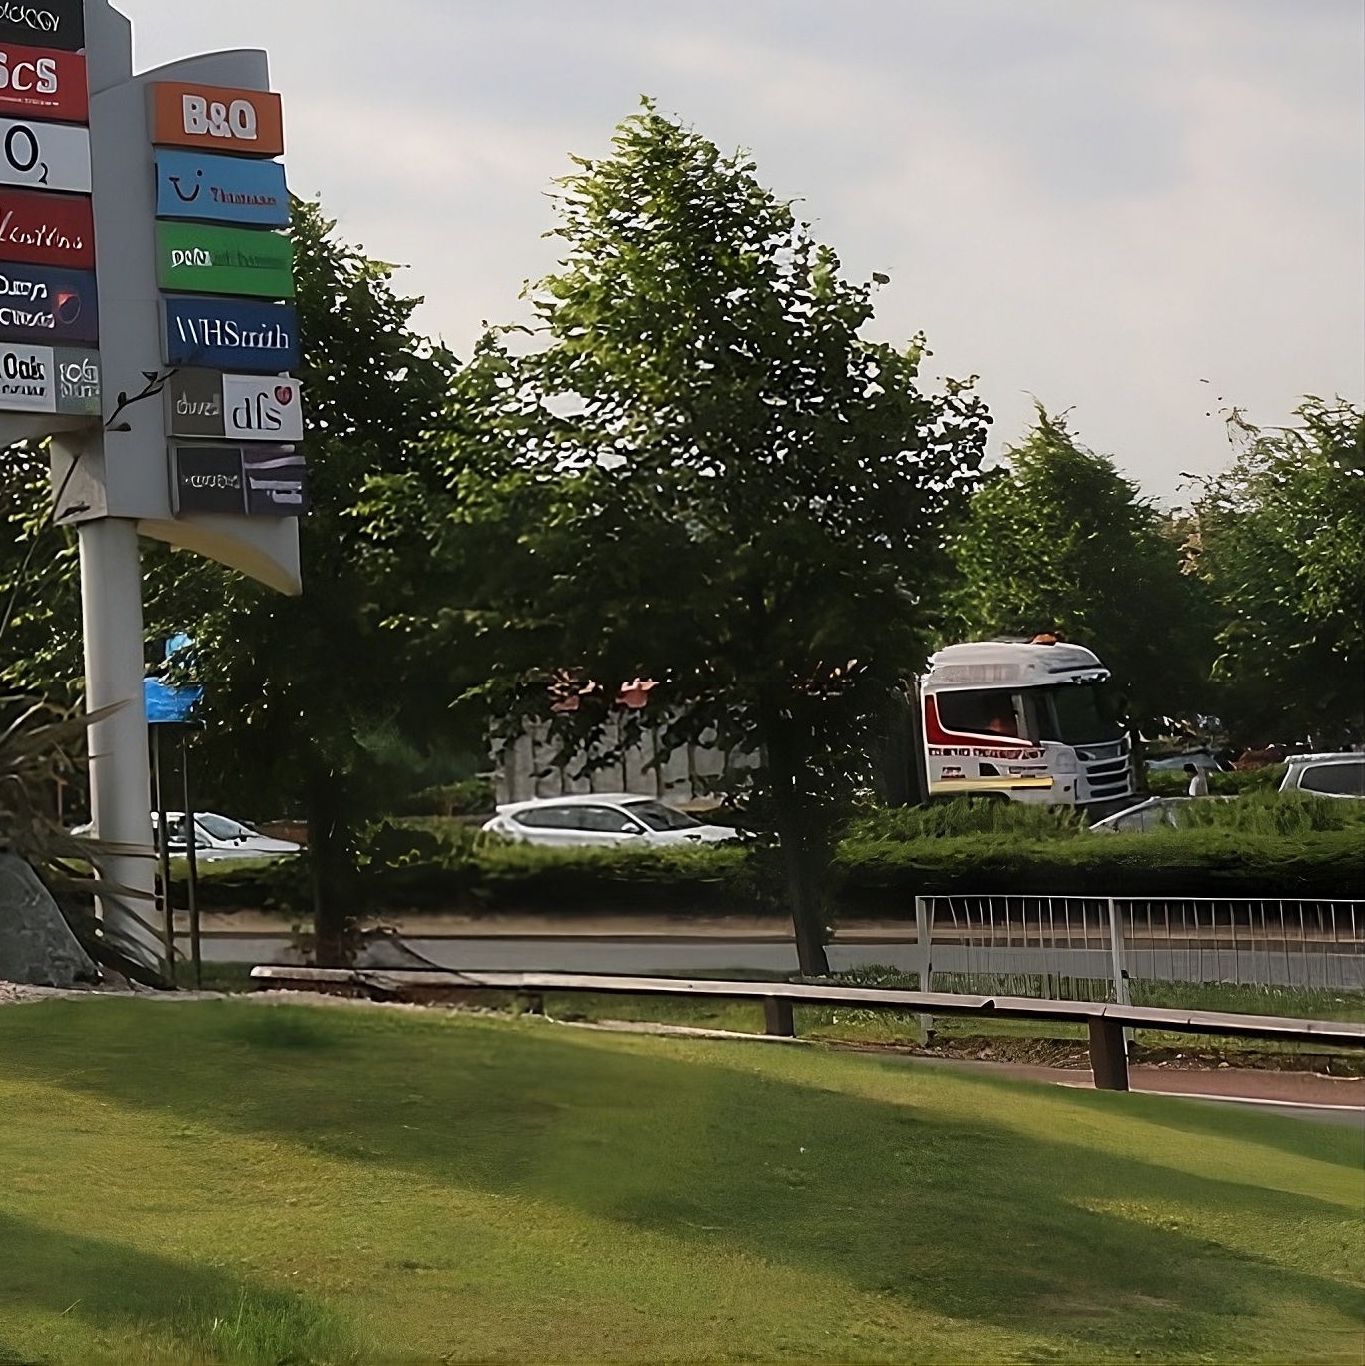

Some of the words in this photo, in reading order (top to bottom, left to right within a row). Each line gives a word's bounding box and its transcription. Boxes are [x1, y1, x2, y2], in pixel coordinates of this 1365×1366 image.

[182, 93, 259, 141] B&Q
[175, 315, 290, 350] WHSmith
[232, 391, 282, 431] dfs
